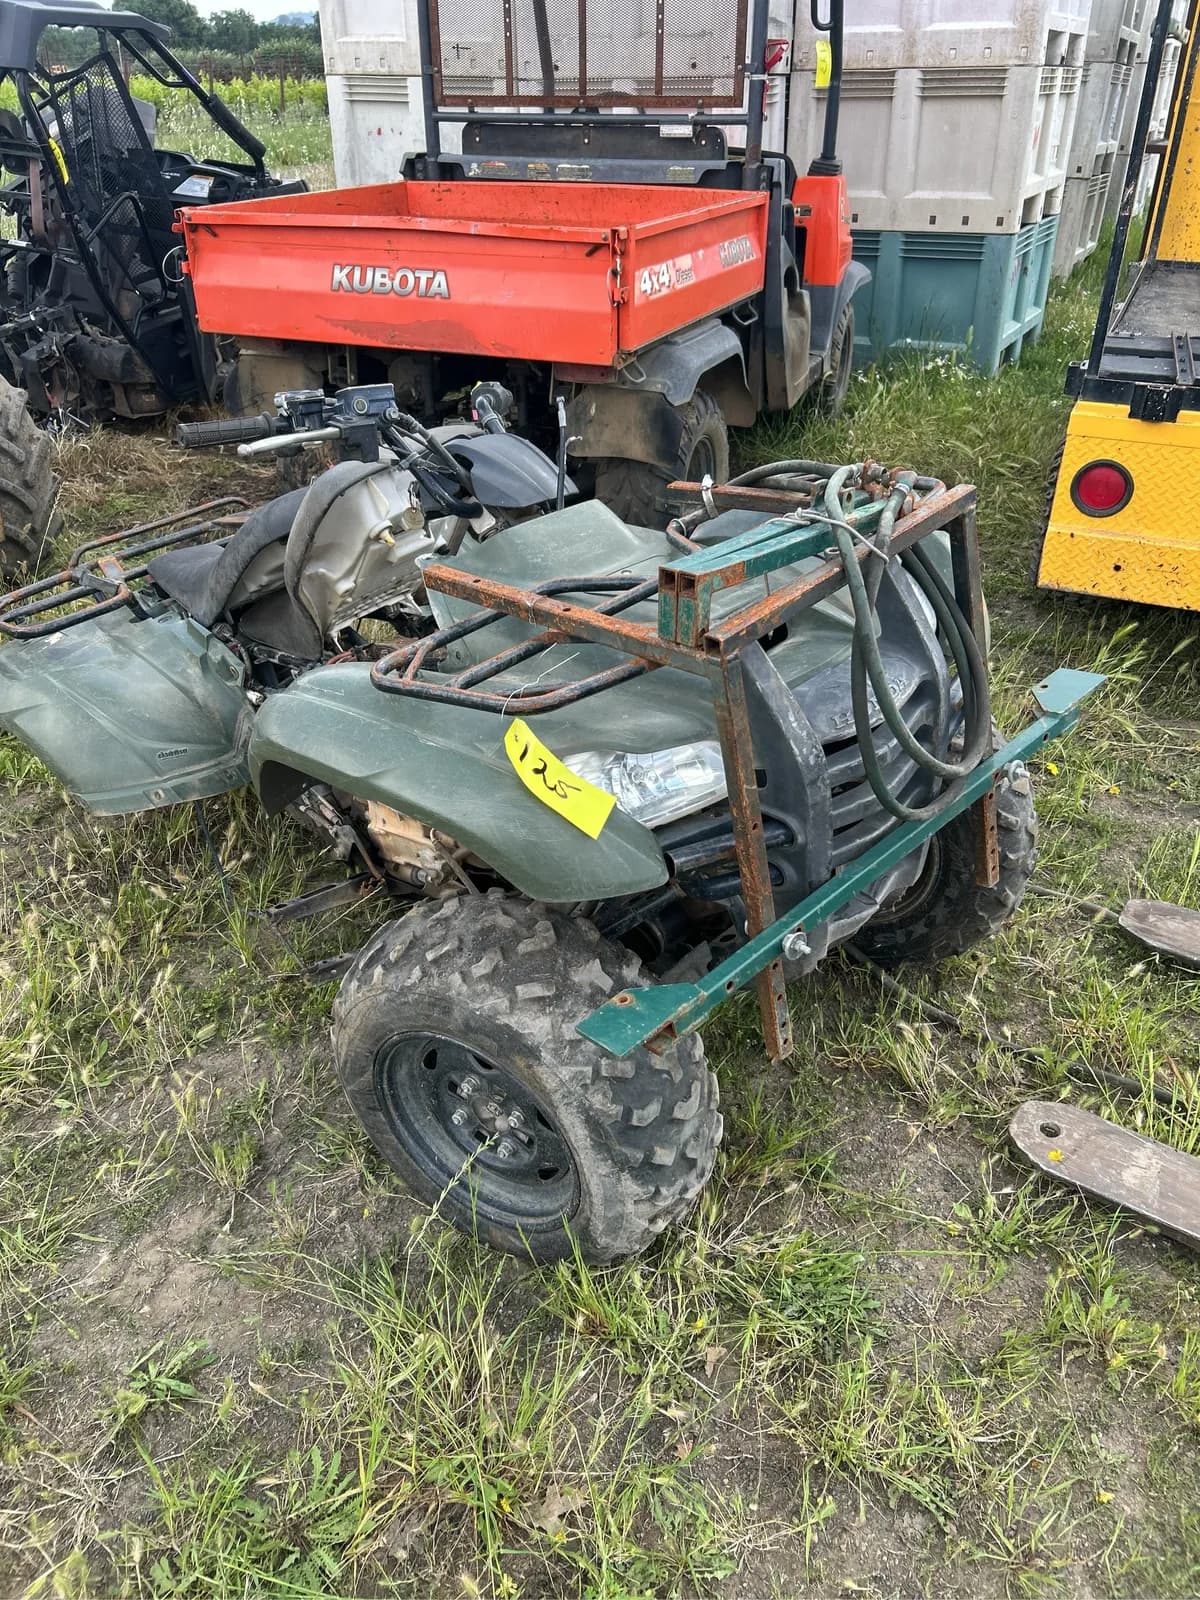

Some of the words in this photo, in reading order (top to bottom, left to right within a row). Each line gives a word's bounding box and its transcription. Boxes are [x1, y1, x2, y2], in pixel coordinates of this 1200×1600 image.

[719, 236, 754, 268] KUBOTA
[331, 264, 450, 299] KUBOTA
[640, 263, 671, 296] 4x4
[519, 743, 582, 799] 125
